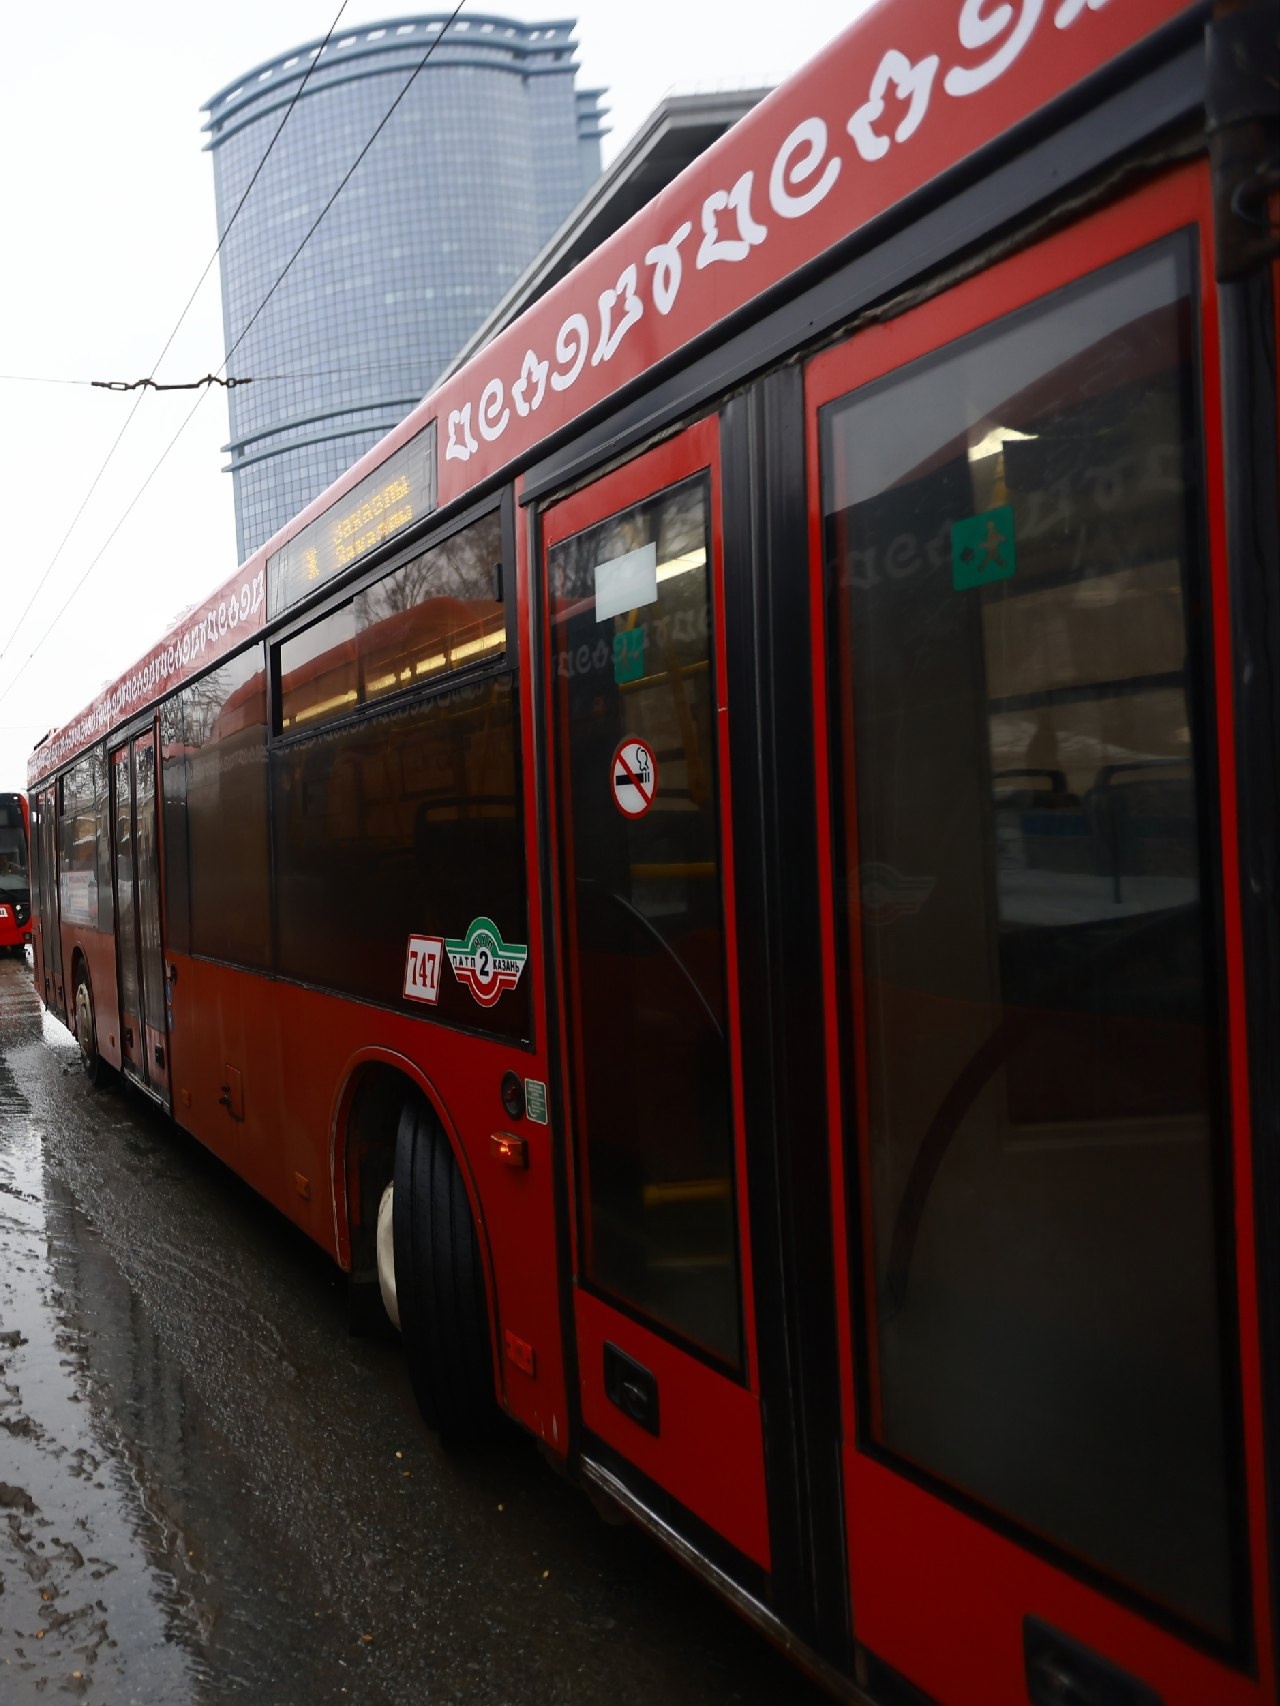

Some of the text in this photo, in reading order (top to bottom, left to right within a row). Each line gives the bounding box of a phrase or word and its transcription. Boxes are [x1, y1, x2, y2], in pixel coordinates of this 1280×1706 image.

[410, 950, 436, 989] 747
[452, 950, 520, 977] ПАТП 2 КАЗАНЬ
